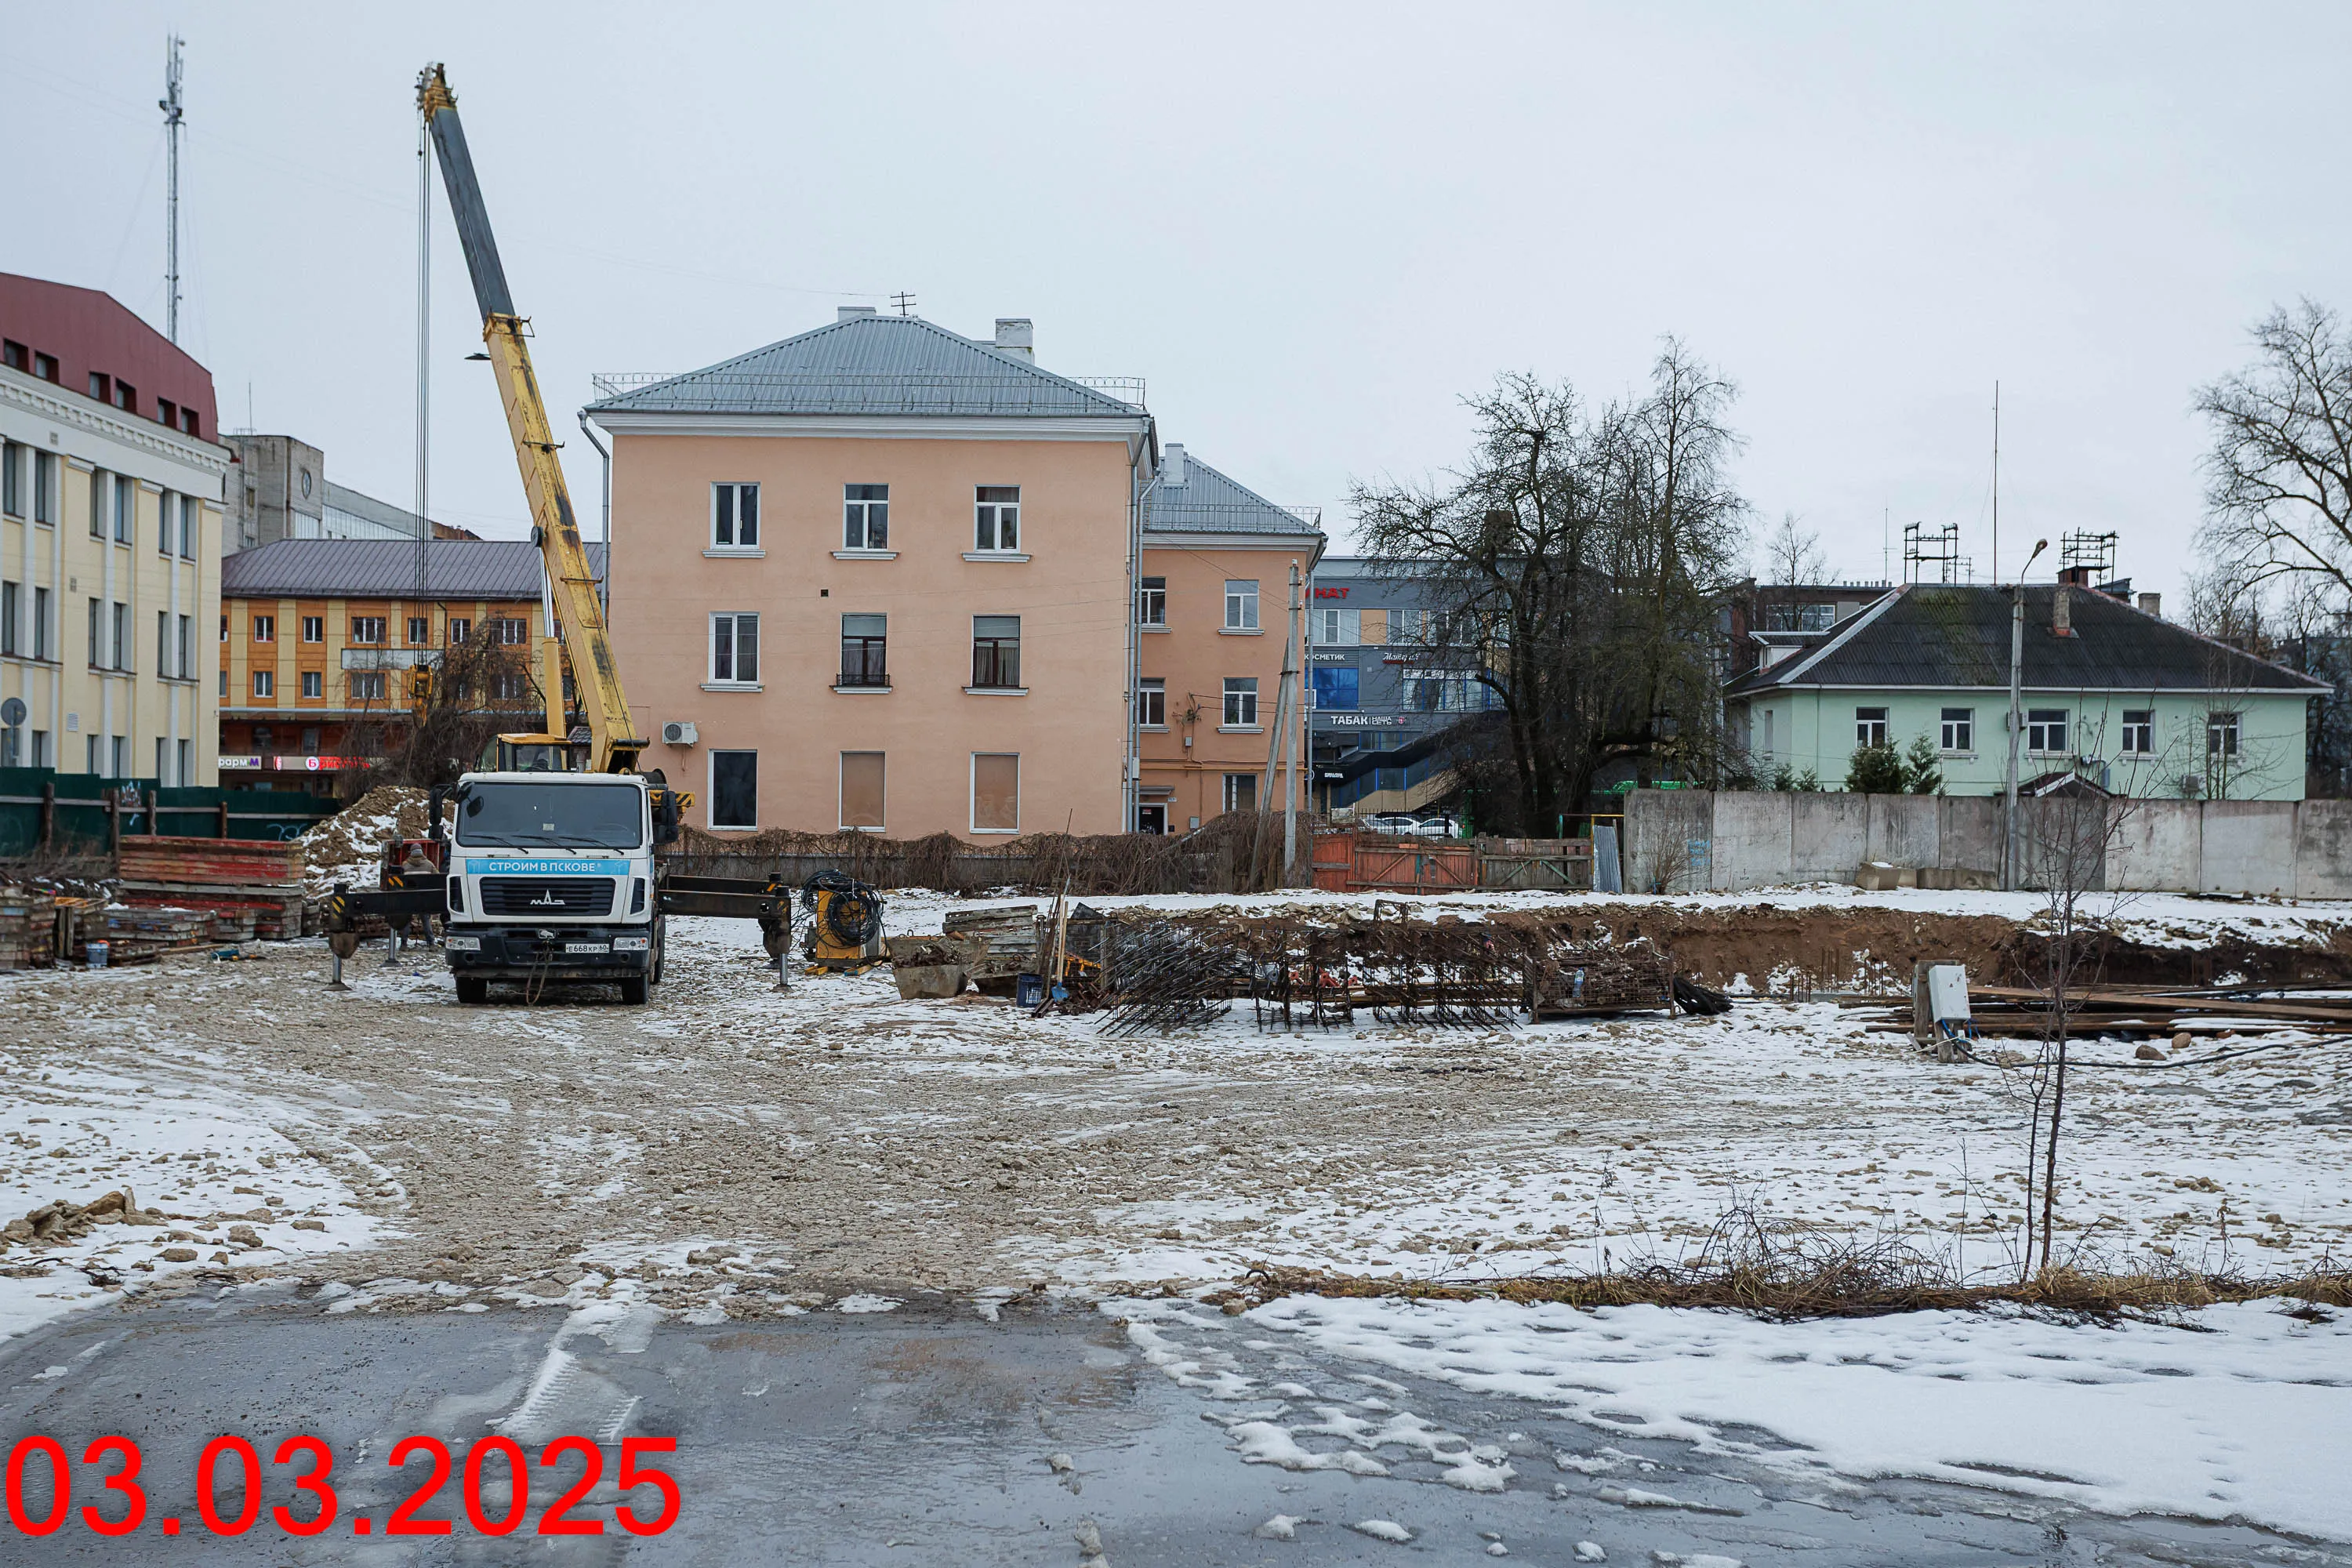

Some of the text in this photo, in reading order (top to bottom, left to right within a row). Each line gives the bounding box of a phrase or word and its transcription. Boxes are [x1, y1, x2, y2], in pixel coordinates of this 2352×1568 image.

[1330, 715, 1368, 725] ТАБАК
[488, 862, 595, 872] СТРОИМ В ПСКОВЕ
